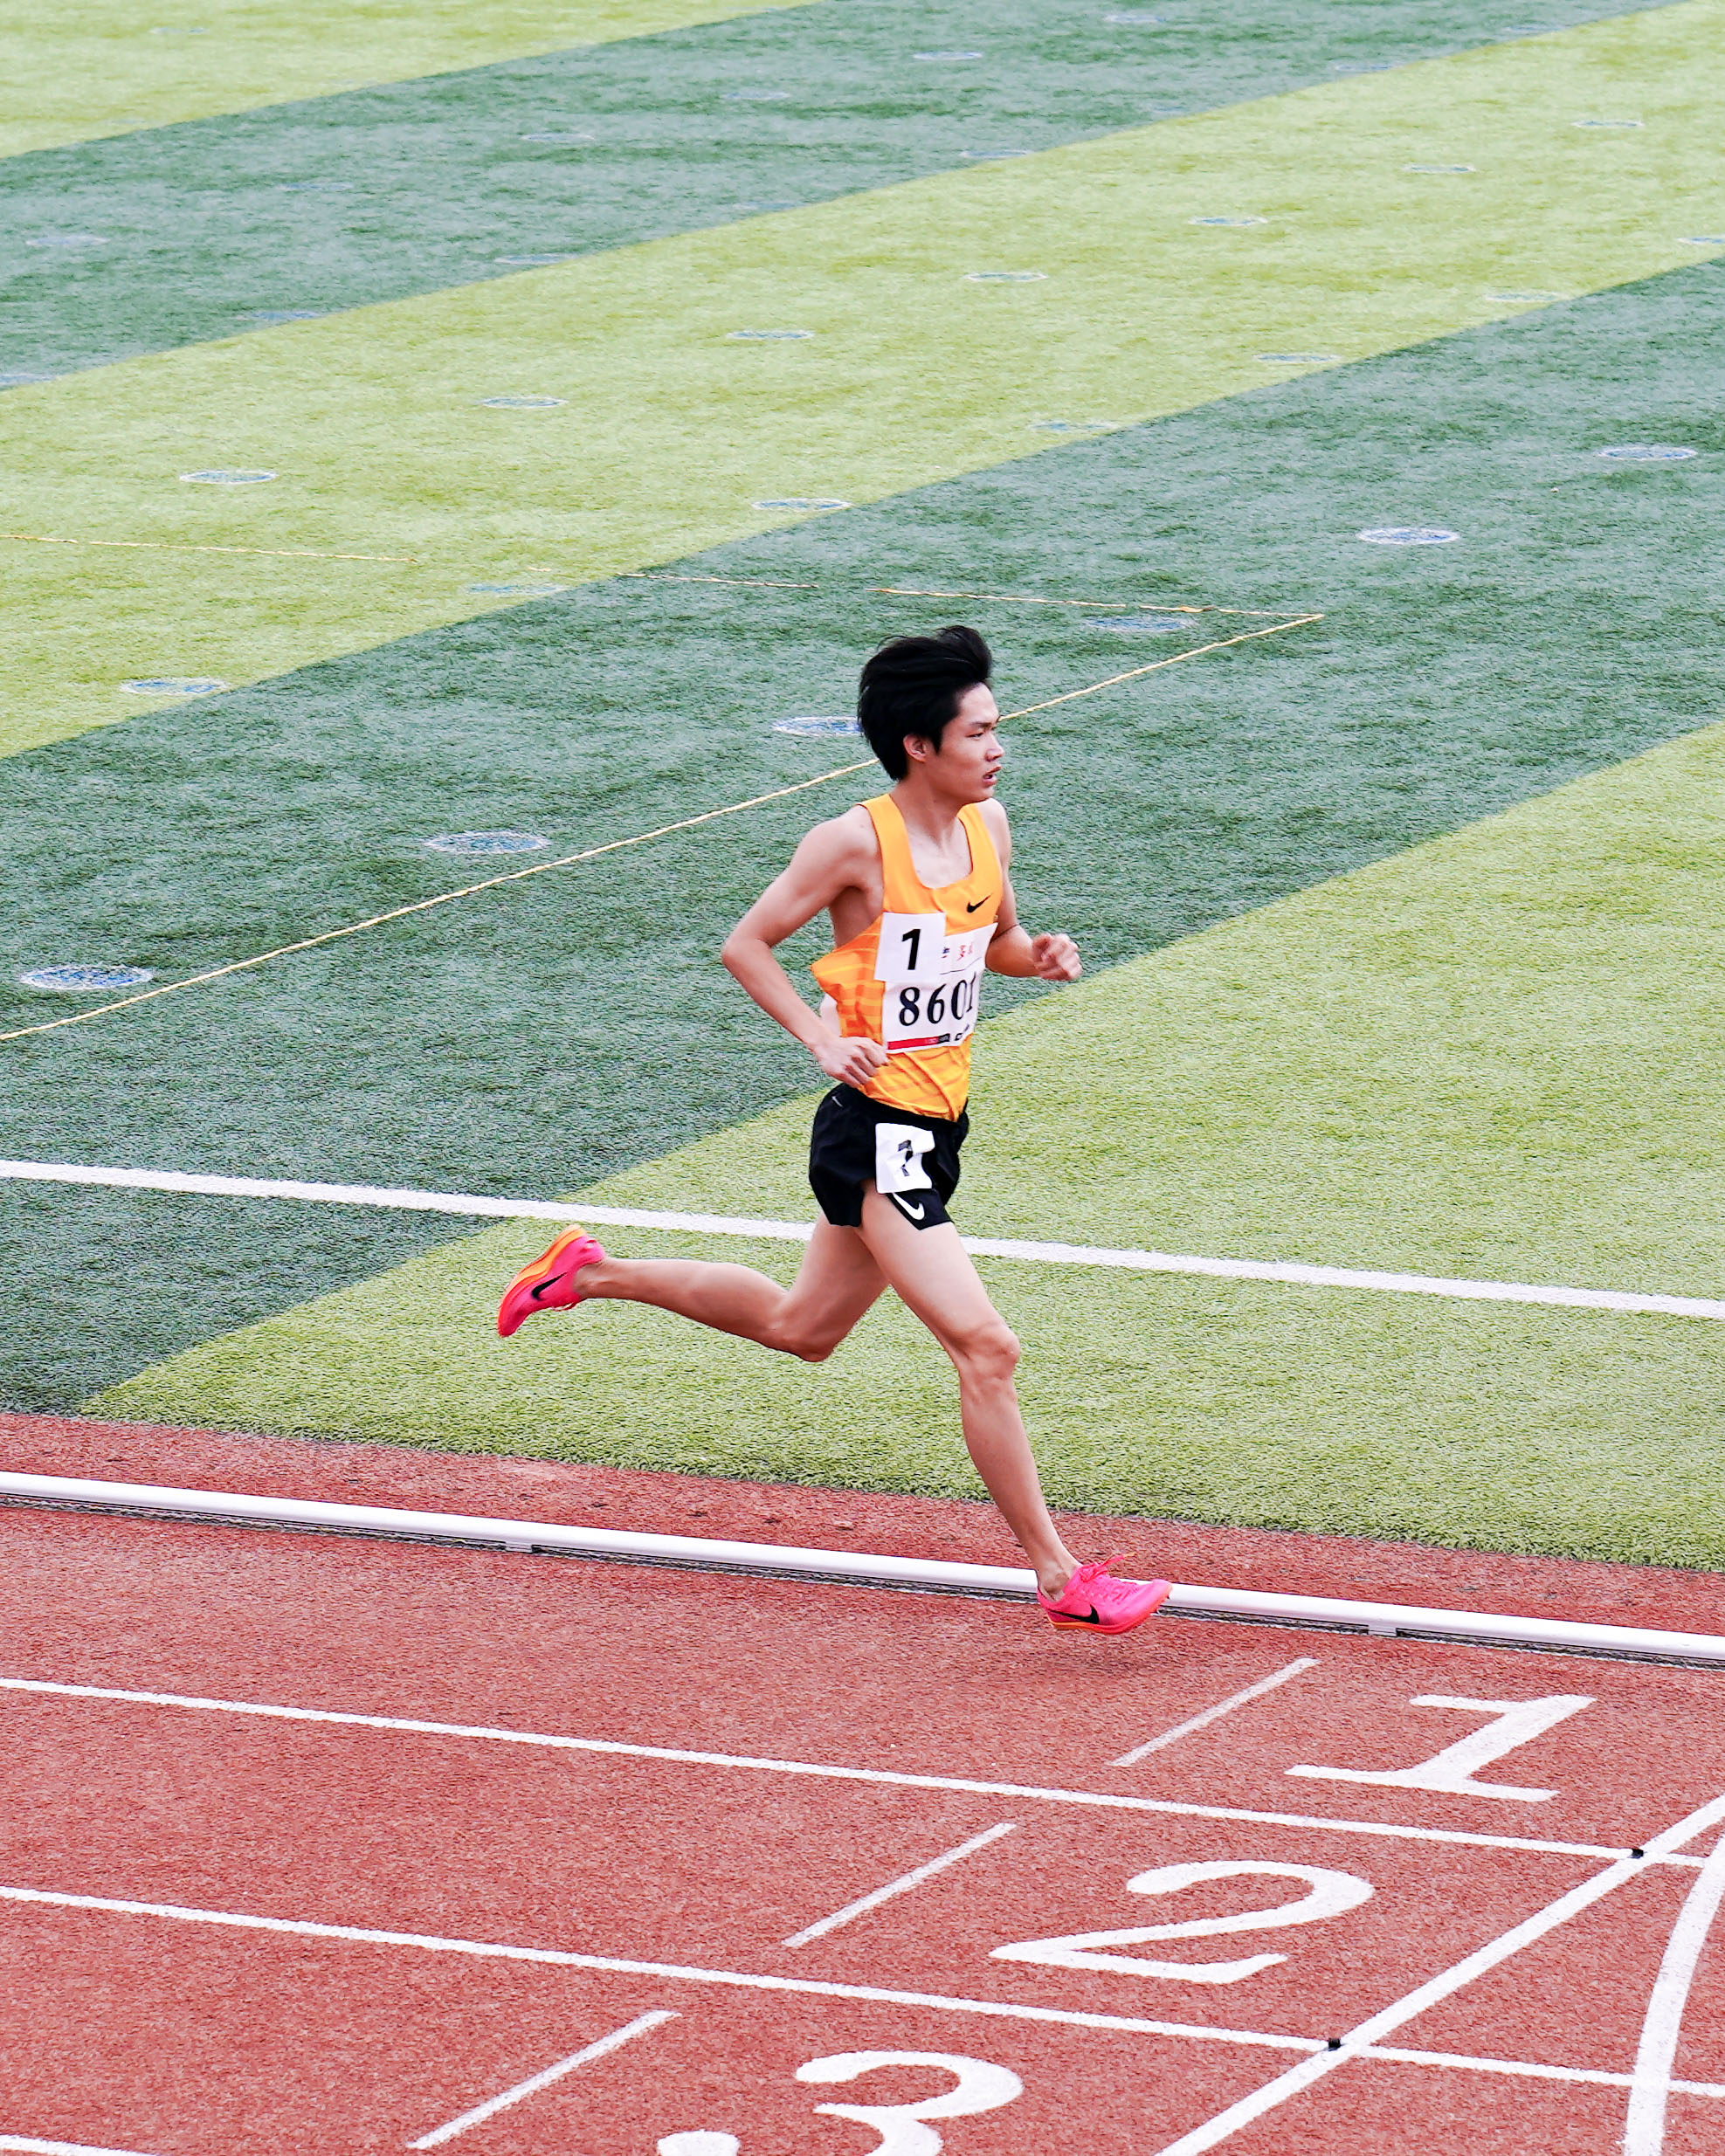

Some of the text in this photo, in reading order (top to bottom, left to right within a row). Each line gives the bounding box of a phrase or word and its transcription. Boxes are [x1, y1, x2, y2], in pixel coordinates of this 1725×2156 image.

[899, 971, 977, 1027] 8601
[901, 928, 921, 971] 1
[1285, 1694, 1596, 1802] 1
[989, 1860, 1375, 1984] 2
[657, 2049, 1024, 2156] 3
